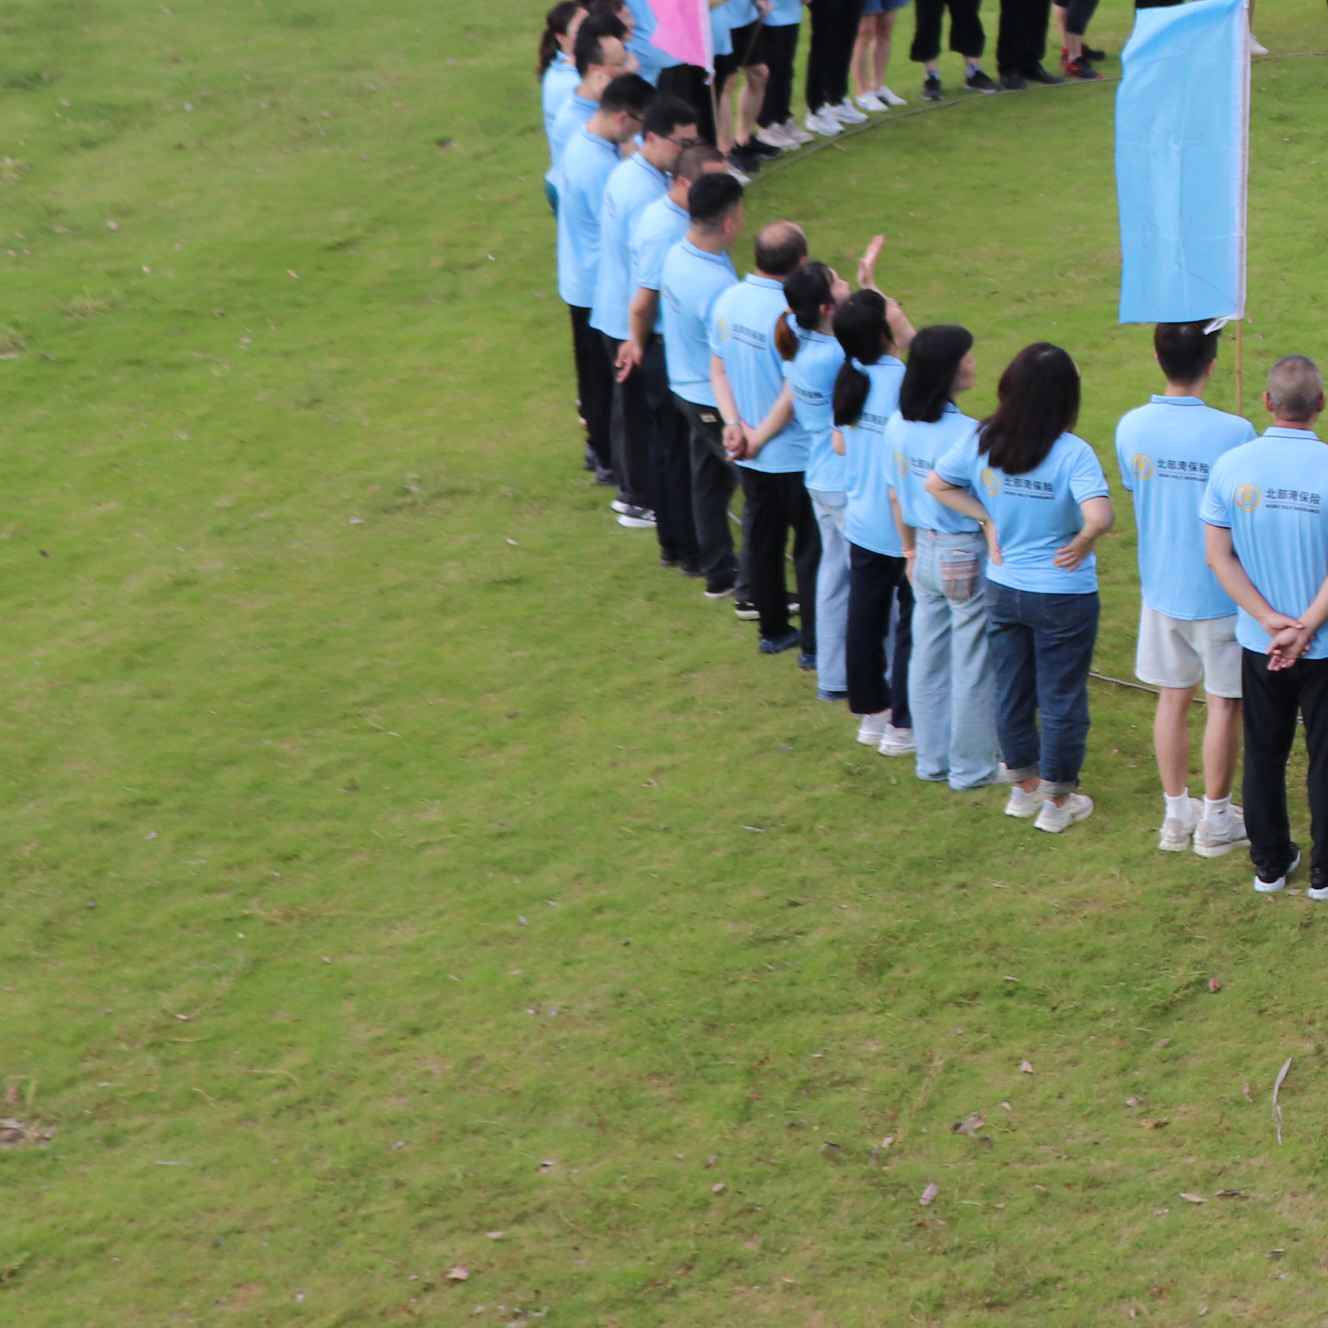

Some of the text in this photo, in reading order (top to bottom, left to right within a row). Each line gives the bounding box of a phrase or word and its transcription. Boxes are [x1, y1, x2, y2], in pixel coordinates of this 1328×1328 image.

[1157, 458, 1210, 474] 北部湾保险
[1265, 487, 1321, 505] 北部湾保险
